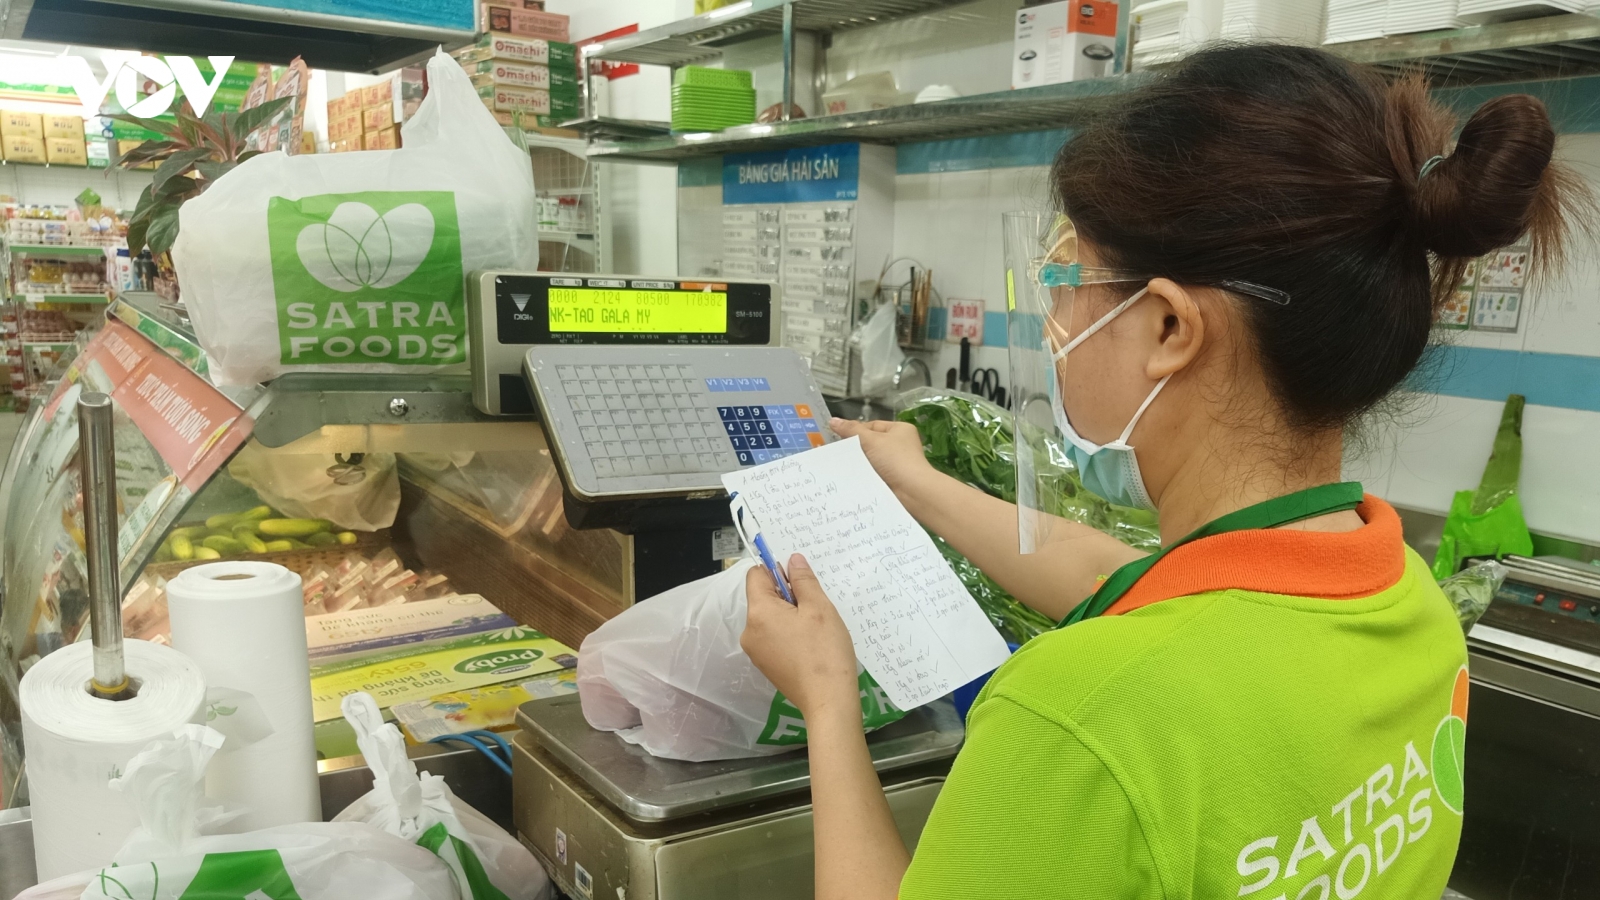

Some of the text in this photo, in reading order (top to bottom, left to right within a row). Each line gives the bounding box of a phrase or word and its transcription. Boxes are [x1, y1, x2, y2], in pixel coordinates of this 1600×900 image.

[739, 153, 839, 184] BẢNG GIÁ HẢI SẢN
[287, 301, 456, 329] SATRA
[601, 308, 630, 324] GALA
[636, 309, 651, 324] MY
[290, 334, 458, 360] FOODS
[176, 406, 212, 444] SỐNG
[737, 408, 745, 416] 8
[728, 423, 735, 432] 4
[760, 422, 766, 430] 6
[734, 437, 773, 446] 1 2 3
[740, 453, 747, 461] 0
[1236, 740, 1429, 897] SATRA
[1271, 788, 1432, 900] ODS
